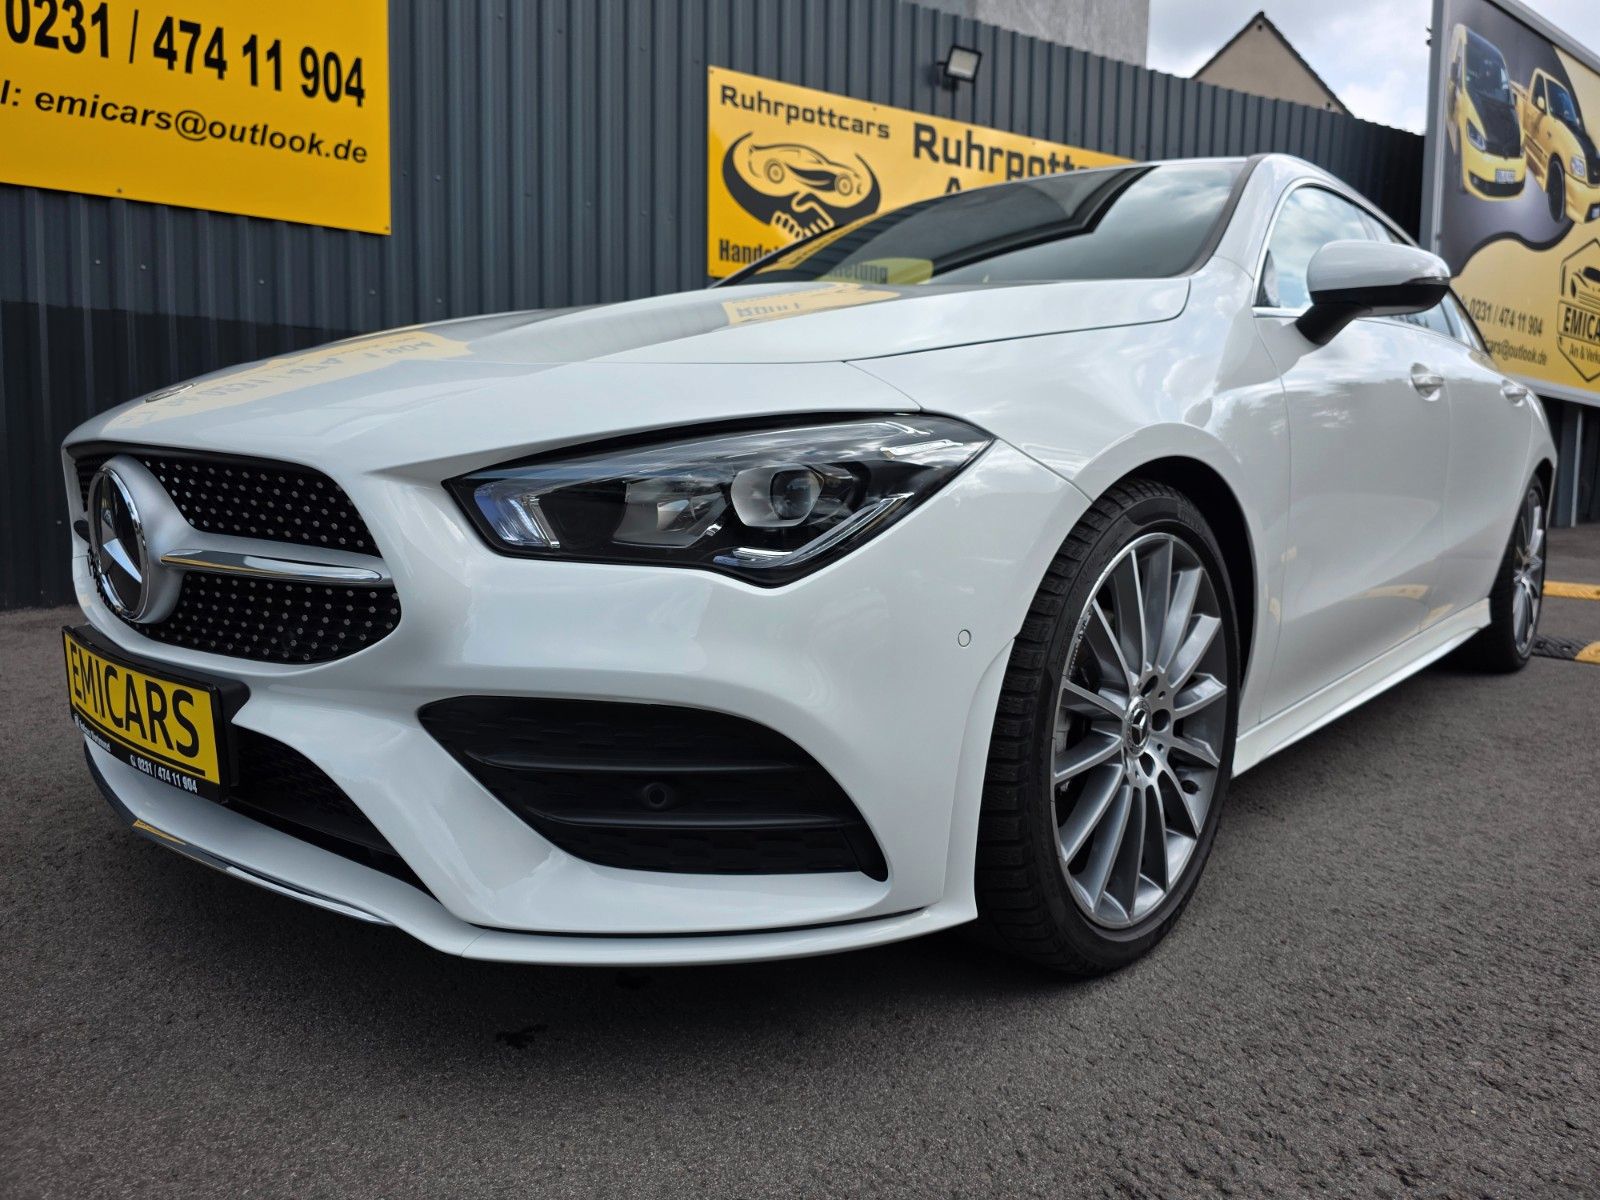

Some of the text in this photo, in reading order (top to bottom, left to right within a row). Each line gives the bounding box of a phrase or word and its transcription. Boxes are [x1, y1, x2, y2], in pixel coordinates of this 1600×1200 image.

[5, 0, 365, 107] 0231 / 474 11 904
[35, 91, 368, 163] emicars@outlook.de
[720, 84, 890, 139] Ruhrpottcars
[913, 122, 1089, 181] Ruhrpott
[1499, 306, 1516, 330] 474
[1518, 311, 1527, 333] 11
[1528, 314, 1543, 337] 904
[70, 643, 199, 758] EMICARS
[137, 756, 153, 775] 0231
[157, 766, 172, 783] 474
[171, 772, 182, 788] 11
[182, 775, 198, 794] 904
